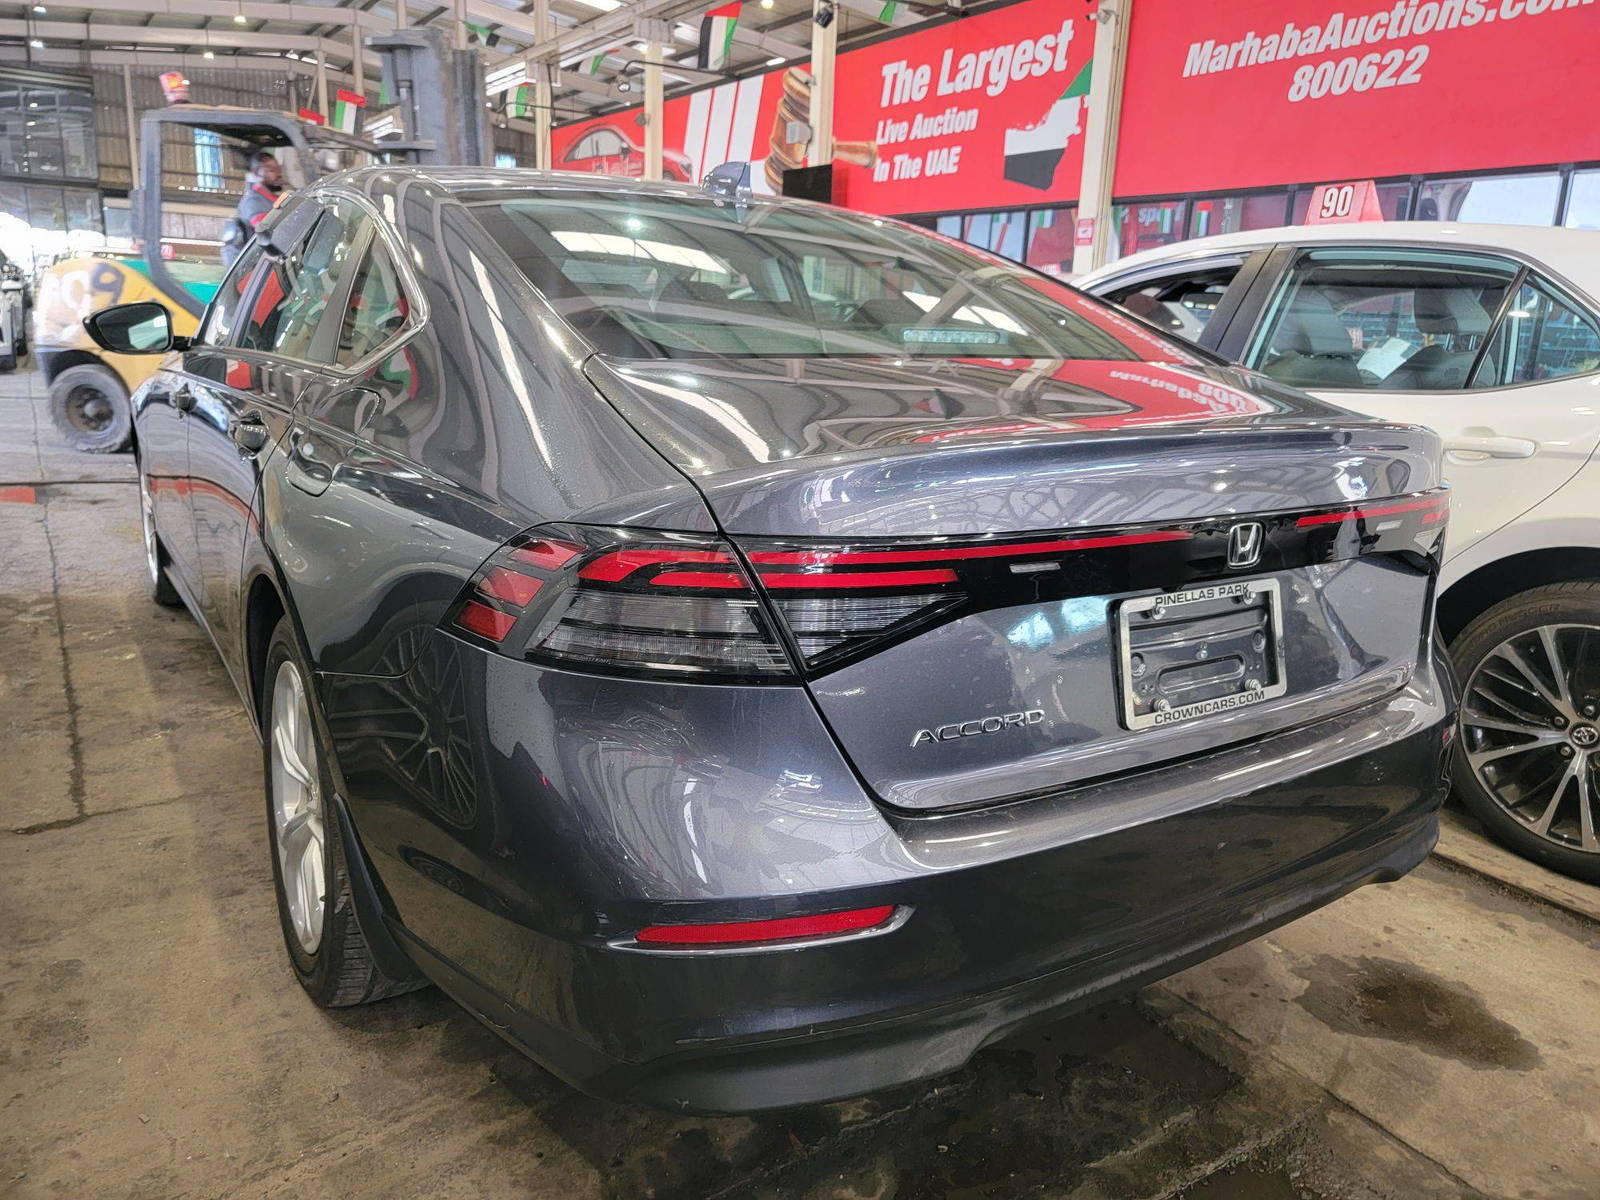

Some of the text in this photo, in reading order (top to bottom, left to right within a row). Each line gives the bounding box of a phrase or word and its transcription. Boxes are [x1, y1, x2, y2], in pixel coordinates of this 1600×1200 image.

[880, 19, 1074, 108] The Largest
[1288, 45, 1429, 102] 800622
[876, 106, 979, 145] Live Auction
[873, 146, 962, 182] In The UAE
[1320, 185, 1353, 218] 90
[1154, 583, 1249, 606] PINELLAS PARK
[1154, 690, 1265, 725] CROWNCARS.COM
[910, 709, 1046, 748] ACCORD
